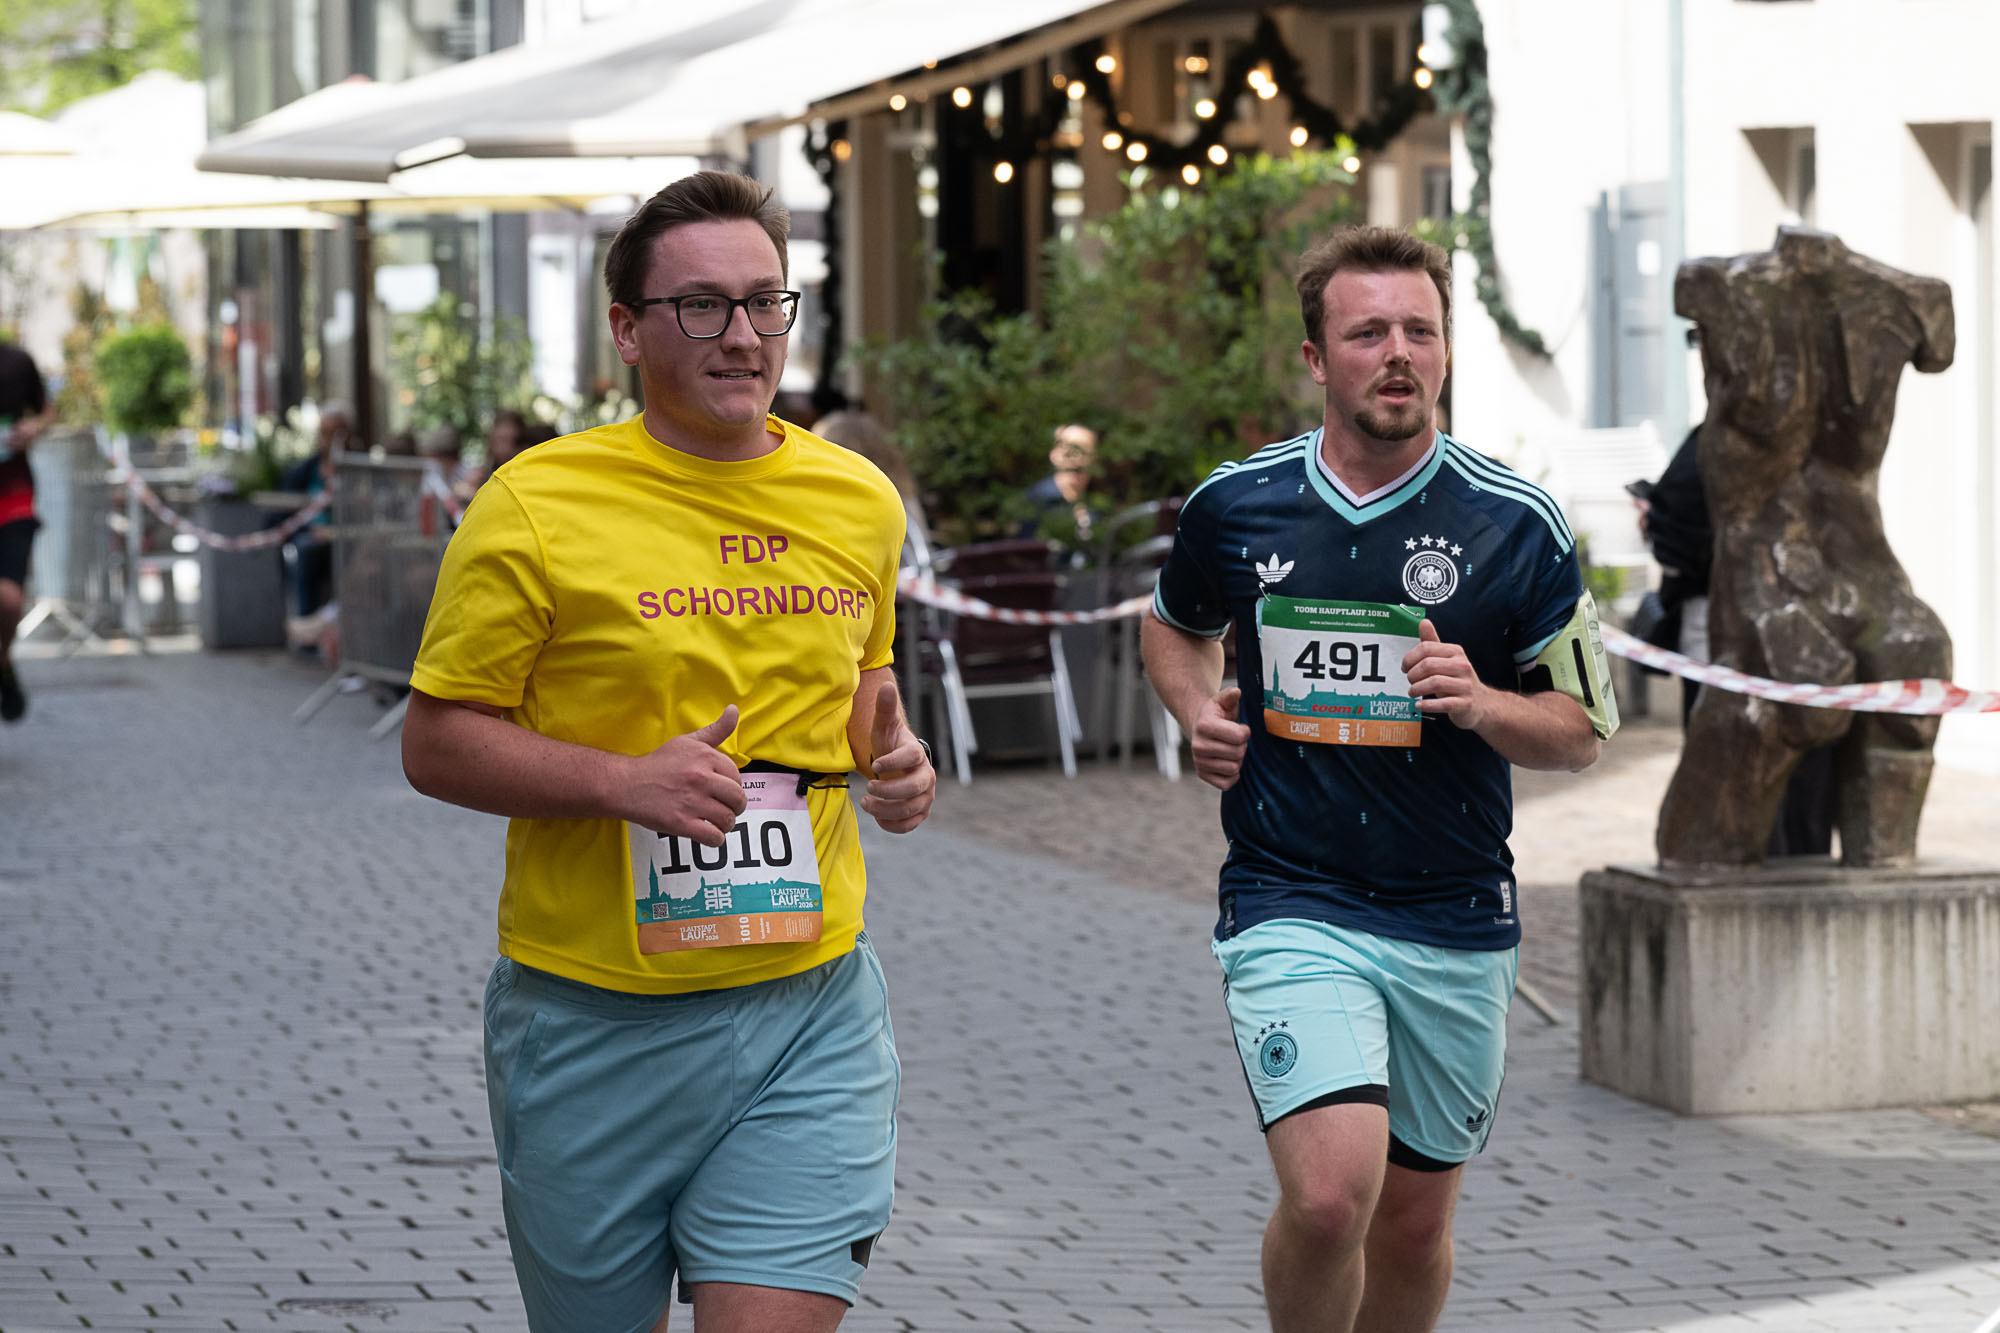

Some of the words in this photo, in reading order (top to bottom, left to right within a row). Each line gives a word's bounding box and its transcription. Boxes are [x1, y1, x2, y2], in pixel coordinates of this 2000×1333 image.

[719, 534, 789, 565] FDP
[637, 585, 869, 620] SCHORNDORF
[1294, 605, 1318, 614] TOOM
[1319, 607, 1367, 617] HAUPTLAUF
[1368, 609, 1390, 618] 10KM
[1293, 640, 1386, 683] 491
[1312, 703, 1352, 714] toom
[1369, 705, 1399, 716] LAUF
[1338, 722, 1350, 744] 491
[656, 820, 793, 876] 1010
[769, 887, 810, 896] 13.ALTSTADT
[771, 894, 800, 906] LAUF
[681, 929, 707, 941] LAUF
[739, 916, 751, 943] 1010
